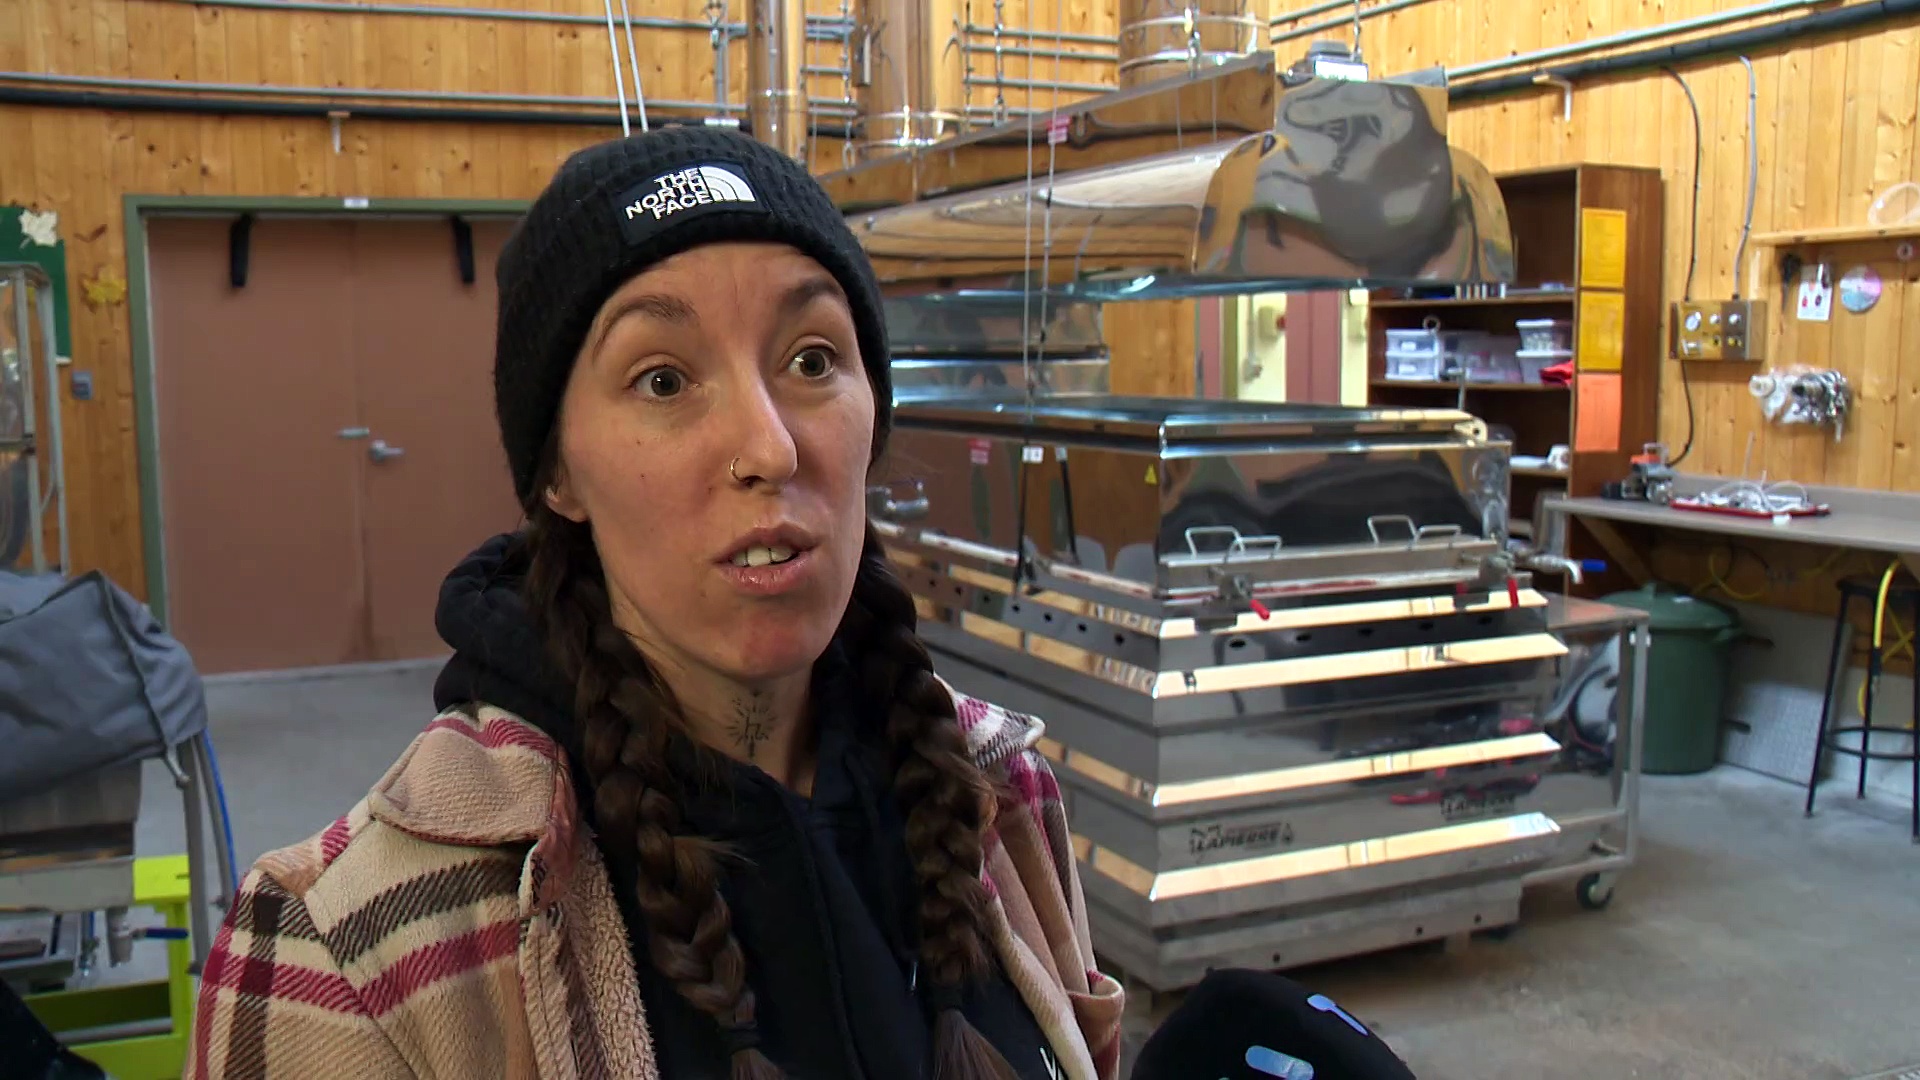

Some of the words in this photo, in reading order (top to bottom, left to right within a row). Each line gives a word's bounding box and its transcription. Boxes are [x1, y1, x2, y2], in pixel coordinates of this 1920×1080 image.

[654, 168, 699, 188] THE
[625, 175, 707, 219] NORTH
[652, 190, 714, 219] FACE
